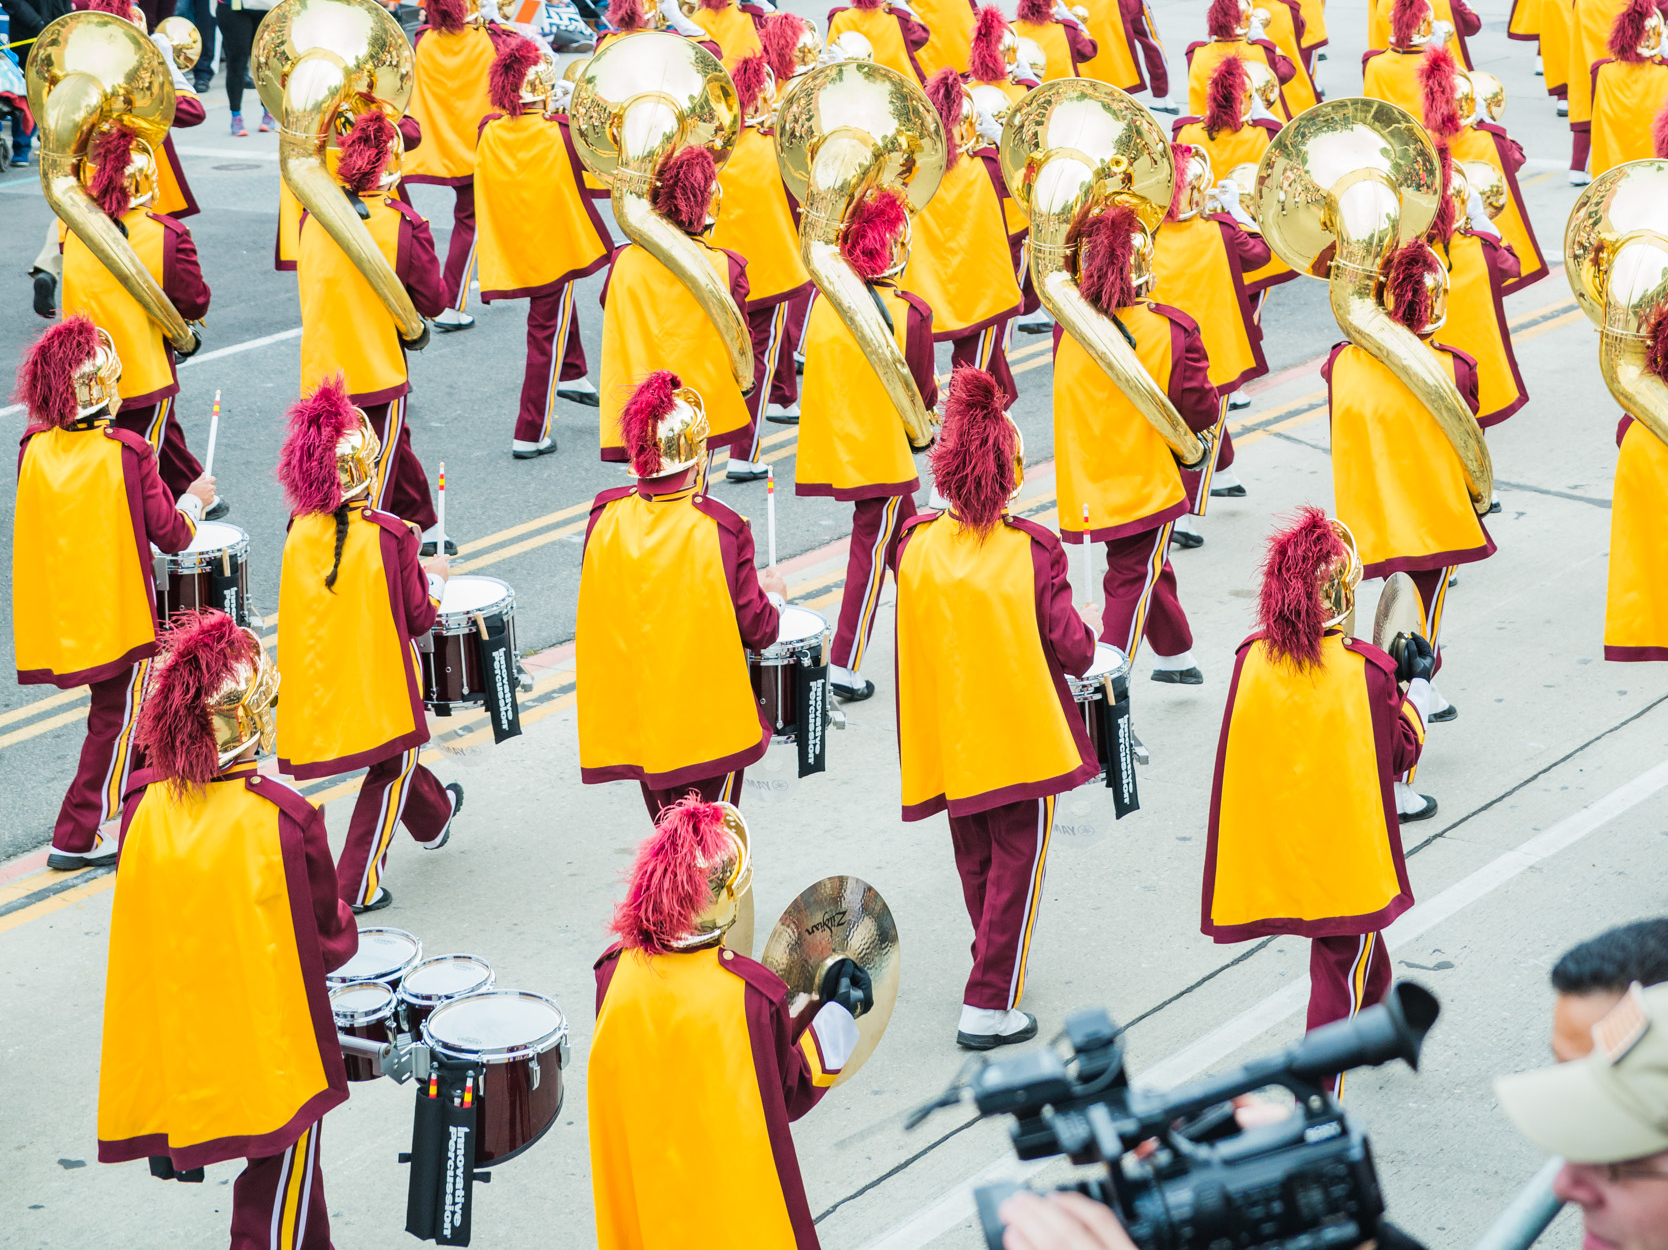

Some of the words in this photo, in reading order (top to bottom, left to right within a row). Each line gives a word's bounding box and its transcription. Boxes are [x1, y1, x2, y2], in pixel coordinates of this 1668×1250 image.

[492, 650, 508, 730] Percussion
[498, 647, 513, 720] Innovative
[808, 681, 817, 764] Percussion
[815, 679, 825, 755] Innovative
[1117, 718, 1130, 804] Percussion
[1123, 714, 1133, 793] Innovative
[804, 909, 848, 938] Zildjian
[443, 1125, 457, 1239] Percussion
[453, 1126, 470, 1227] Innovative
